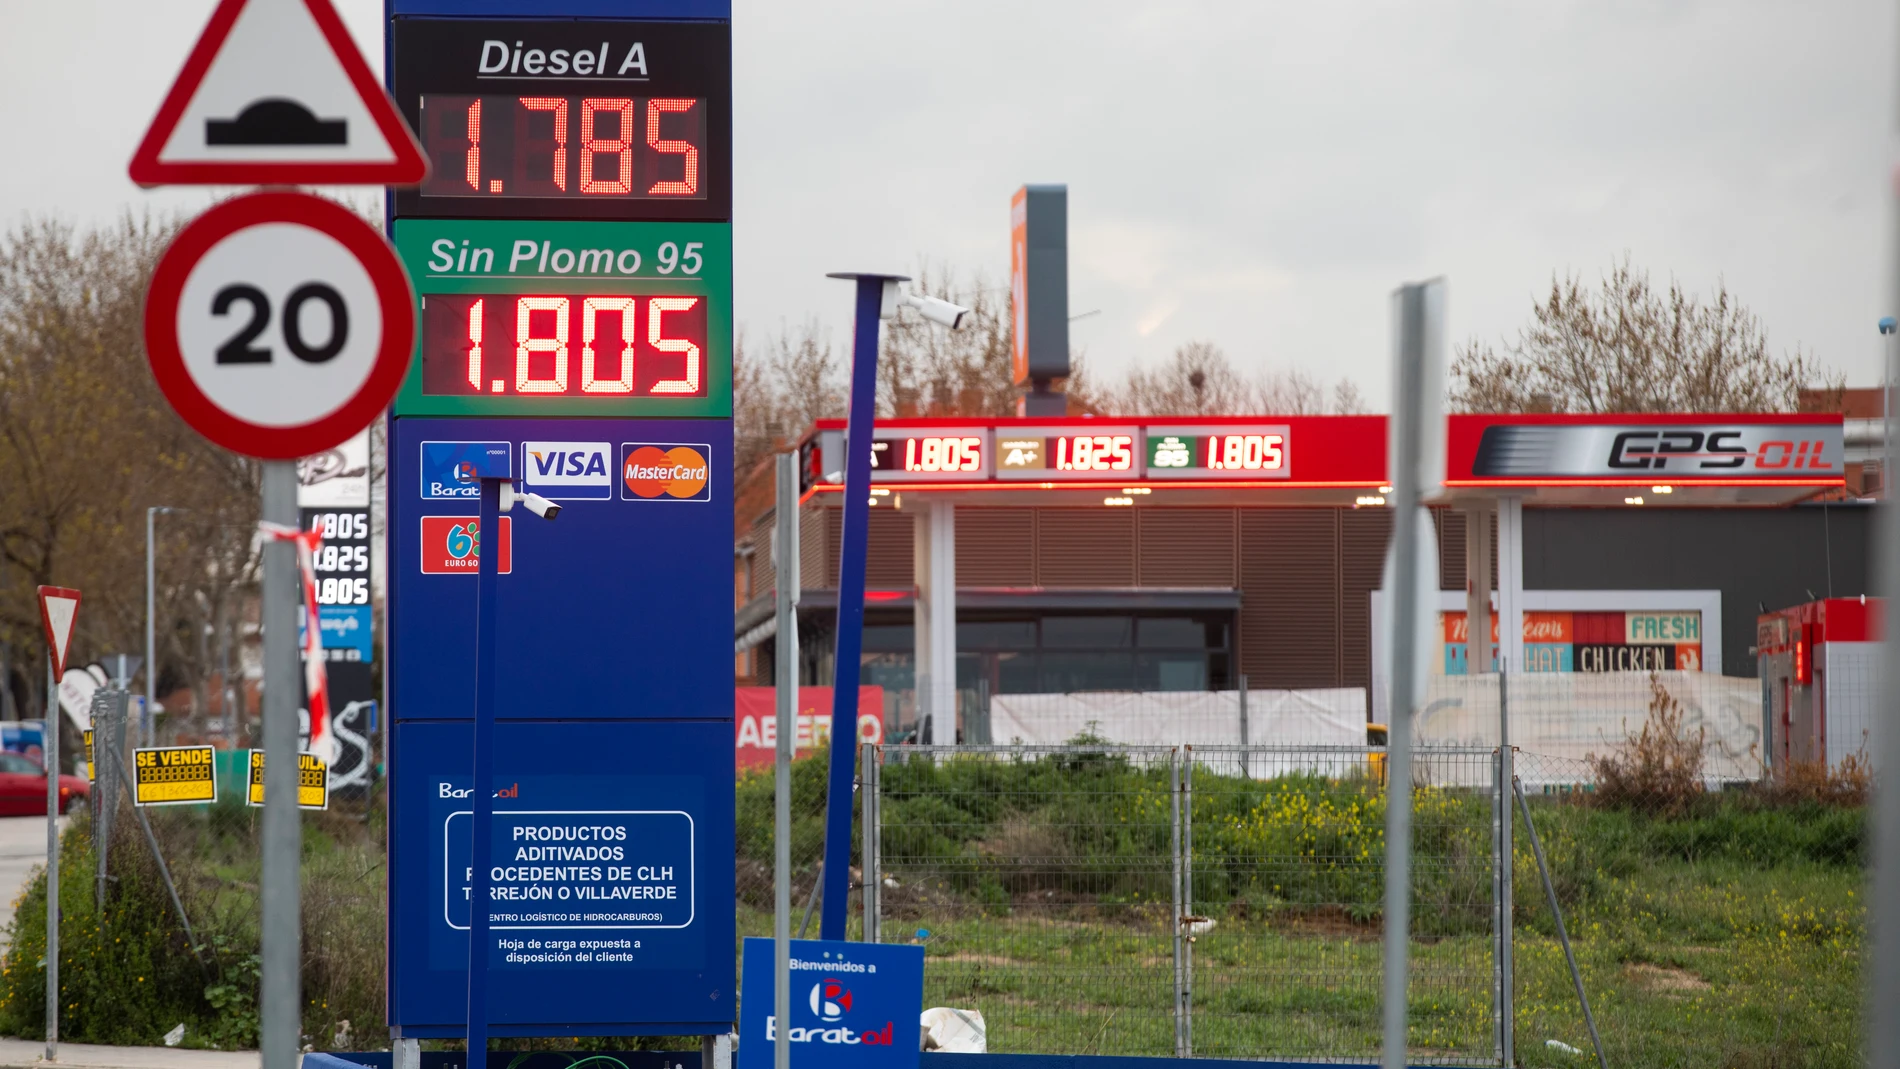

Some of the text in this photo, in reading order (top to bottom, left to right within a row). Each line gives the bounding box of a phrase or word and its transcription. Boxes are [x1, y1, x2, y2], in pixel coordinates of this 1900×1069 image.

[478, 40, 649, 76] Diesel A
[466, 97, 698, 194] 1.785
[428, 239, 704, 275] Sin Plomo 95
[210, 280, 350, 366] 20
[467, 297, 700, 393] 1.805
[905, 437, 981, 472] 1.805
[1004, 448, 1038, 466] A+
[1056, 436, 1132, 471] 1.825
[1207, 435, 1283, 470] 1.805
[1607, 431, 1833, 470] GPS OIL
[528, 451, 607, 476] VISA
[625, 464, 706, 480] MasterCard
[431, 482, 481, 496] Barat
[444, 559, 466, 567] EURO
[1631, 616, 1699, 639] FRESH
[1581, 646, 1666, 673] CHICKEN
[736, 714, 881, 749] ABERO
[137, 749, 212, 767] SE VENDE
[439, 782, 519, 799] Baroil
[513, 826, 627, 841] PRODUCTOS
[515, 846, 624, 861] ADITIVADOS
[607, 866, 632, 881] DE
[637, 866, 673, 881] CLH
[462, 883, 677, 900] TRREJÓN O VILLAVERDE
[489, 911, 663, 922] ENTRO LOGÍSTICO DE HIDROCARBUROS)
[499, 939, 641, 951] Hoja de carga expuesta a
[506, 952, 634, 964] disposición del cliente
[789, 958, 876, 973] Bienvenidos a
